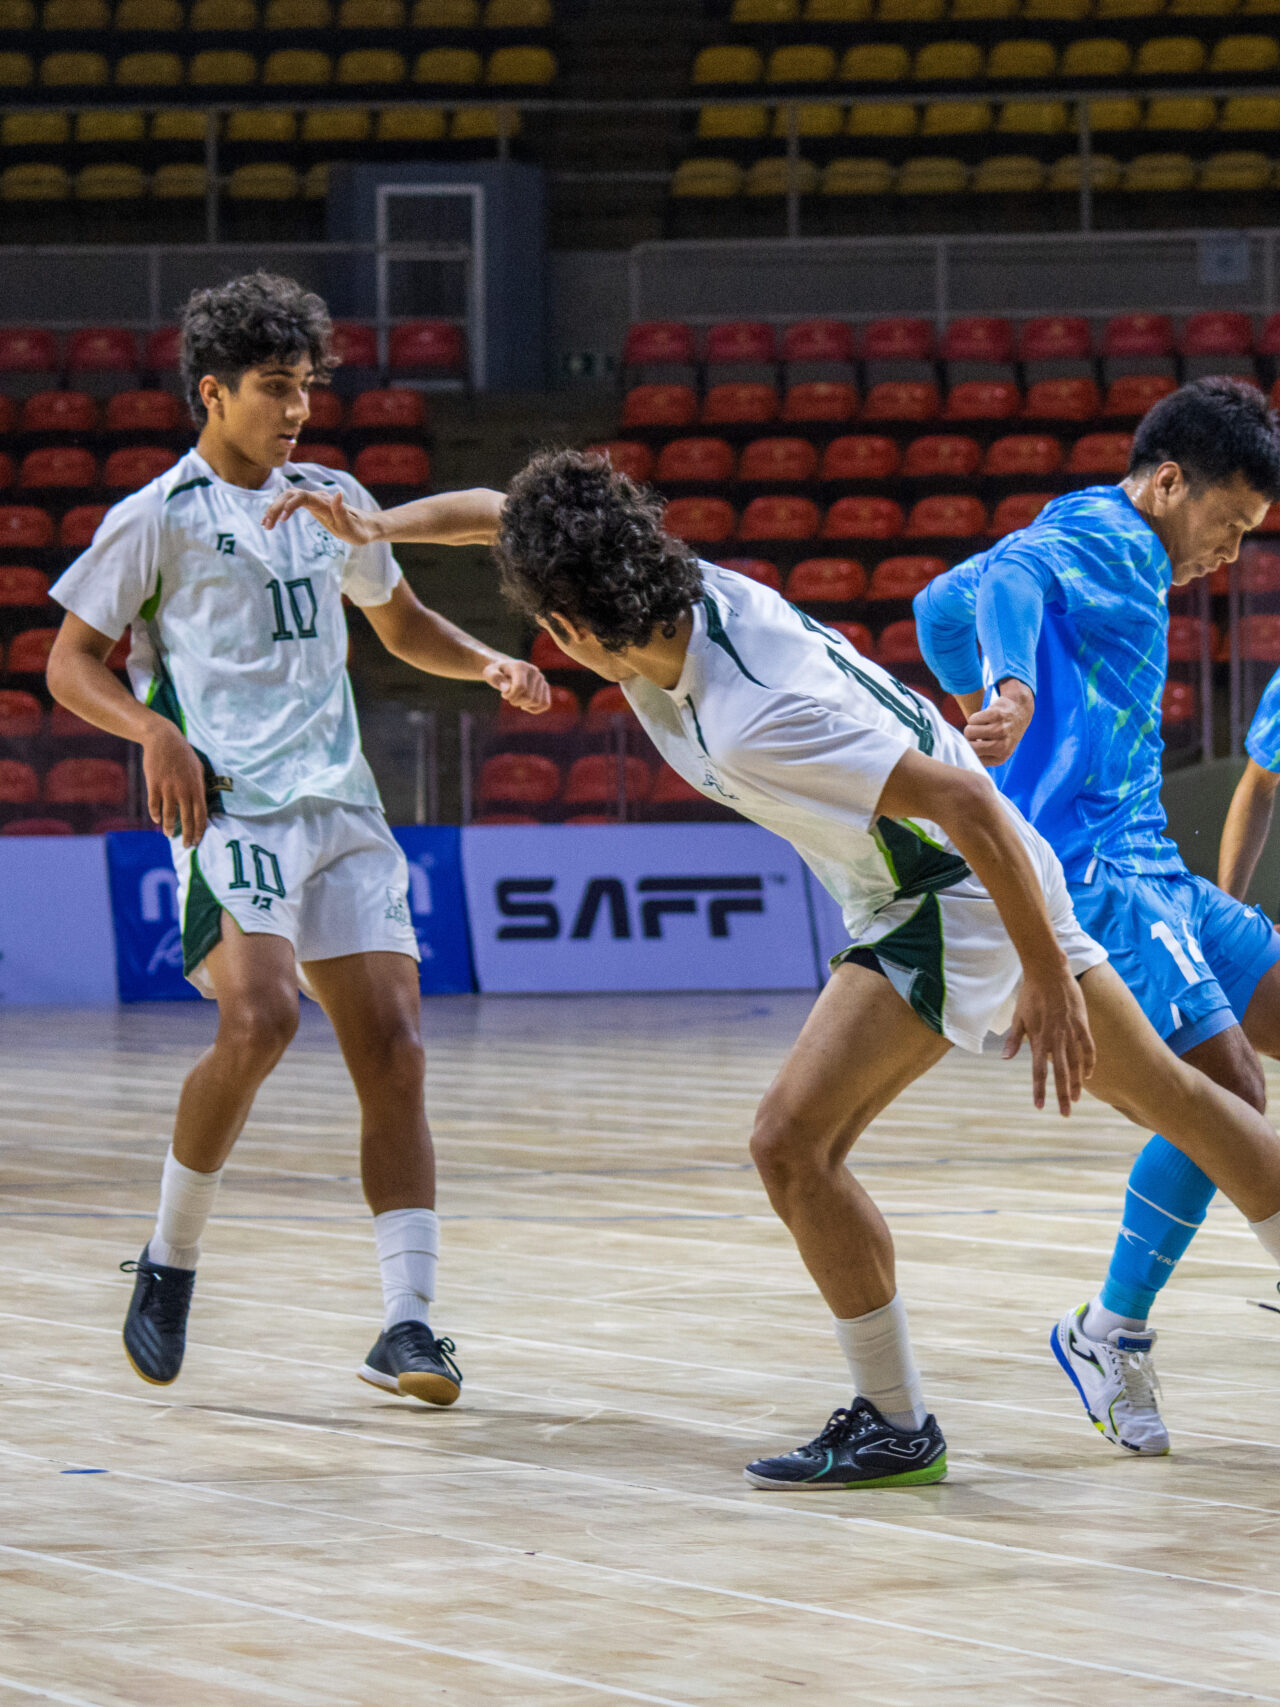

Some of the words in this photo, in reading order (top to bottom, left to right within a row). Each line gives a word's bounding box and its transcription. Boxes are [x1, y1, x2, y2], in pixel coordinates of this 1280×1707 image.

[265, 577, 318, 641] 10
[225, 839, 286, 899] 10
[494, 875, 764, 940] SAFF
